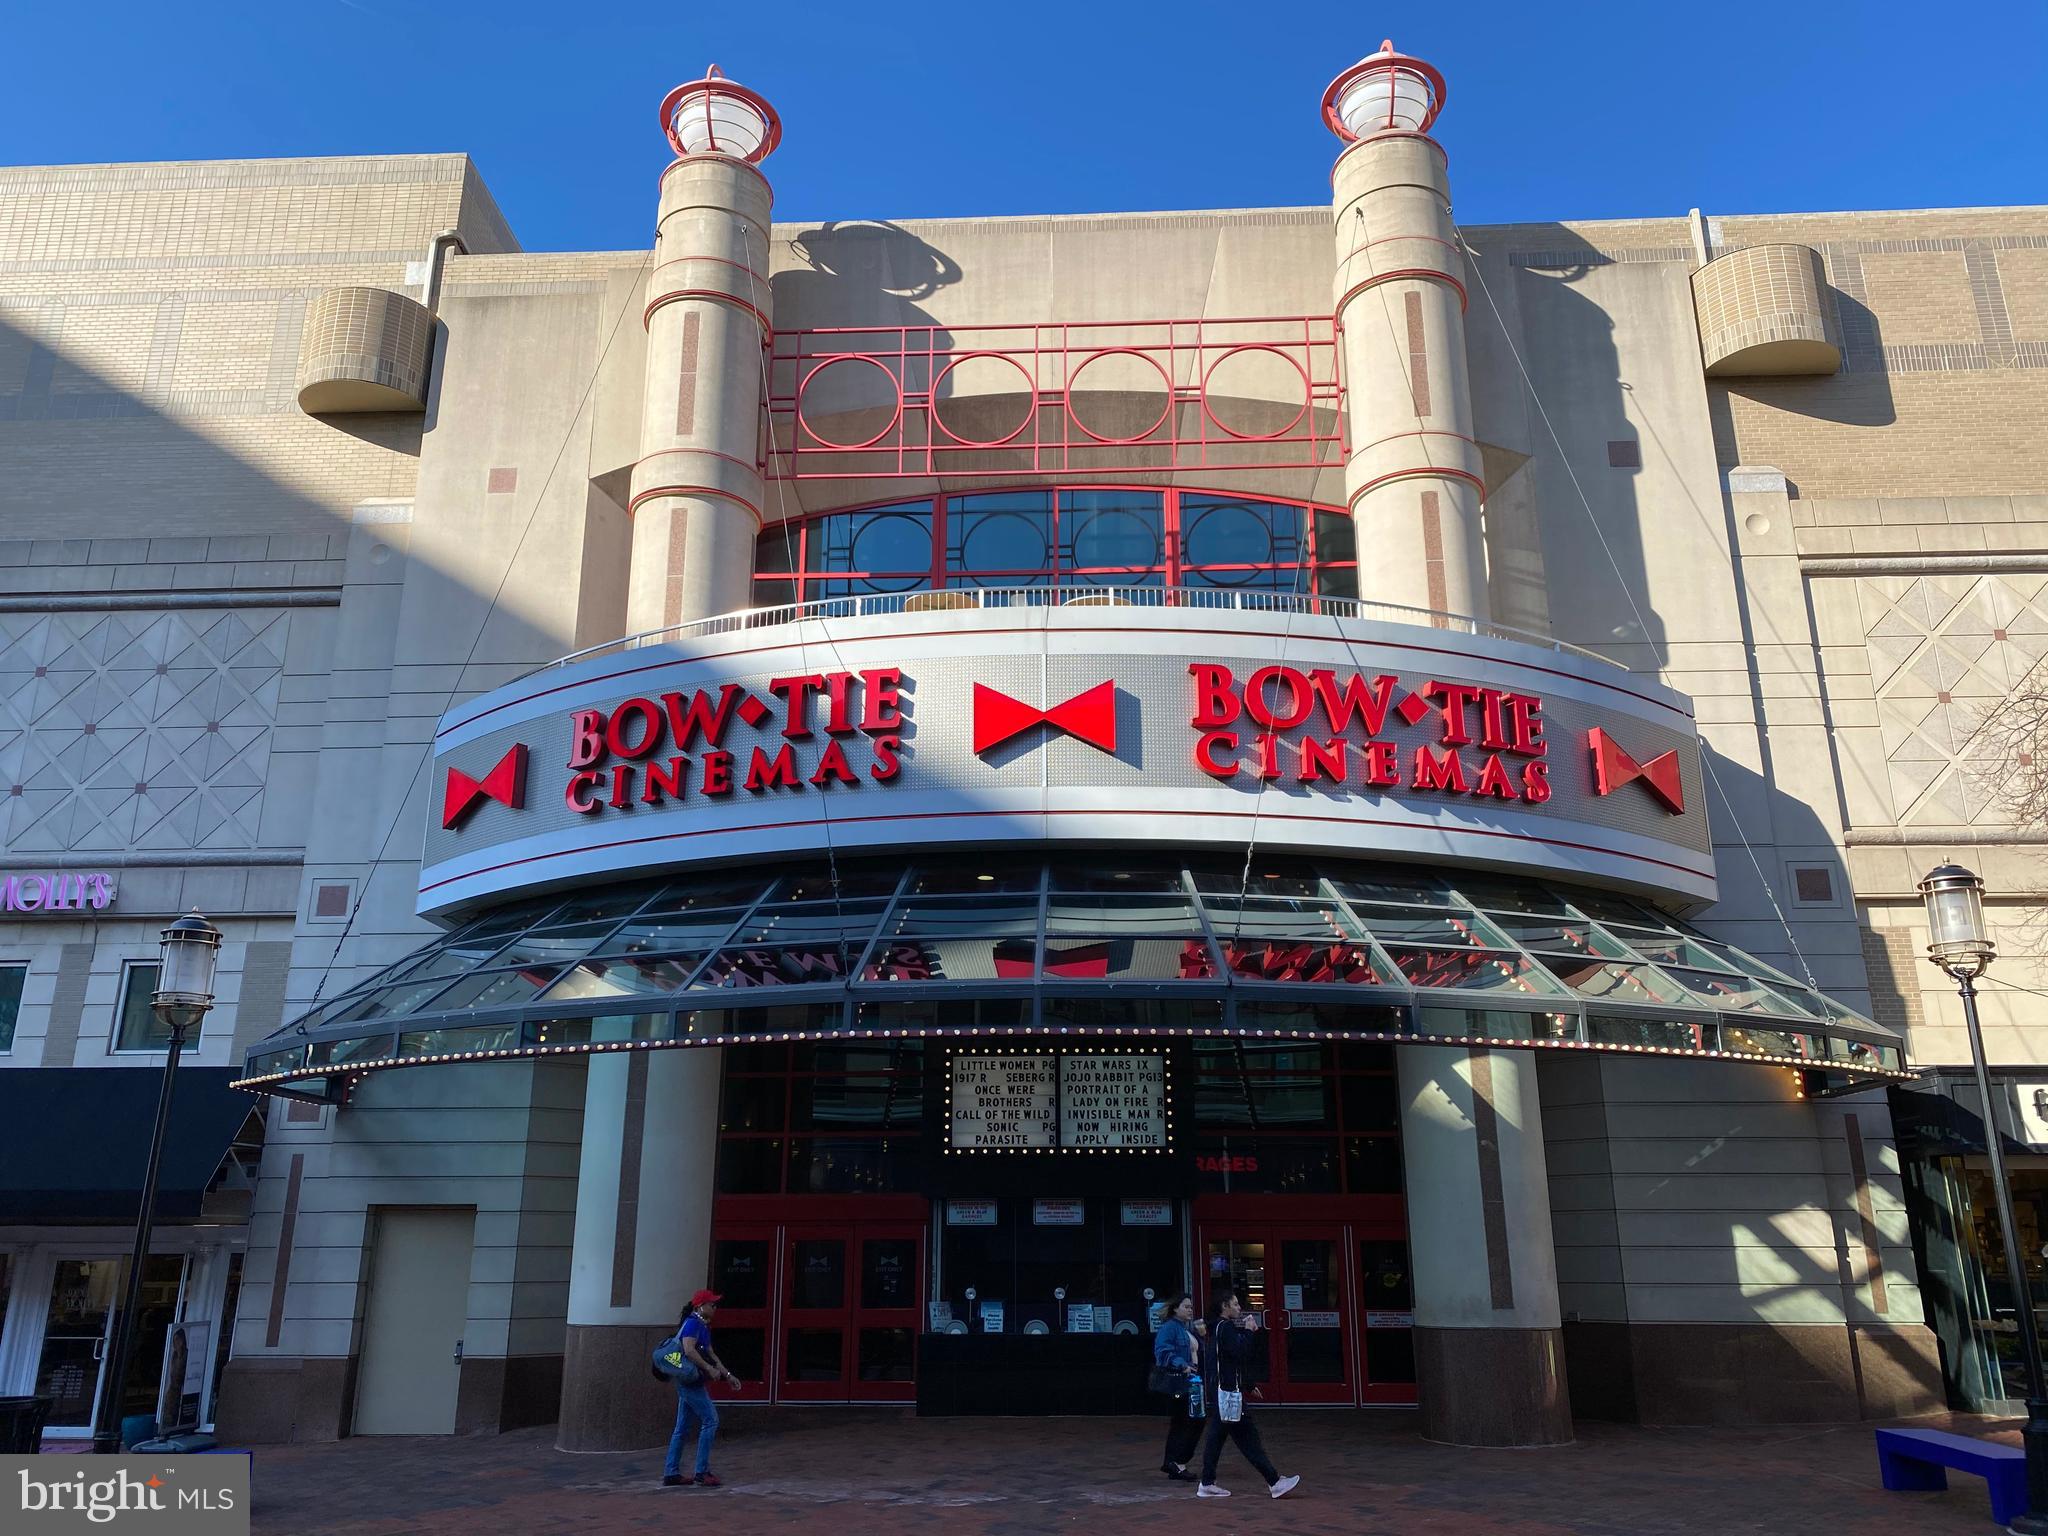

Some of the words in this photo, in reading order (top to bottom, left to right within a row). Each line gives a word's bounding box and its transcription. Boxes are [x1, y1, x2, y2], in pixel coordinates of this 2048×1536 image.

[1194, 730, 1552, 804] CINEMAS
[566, 734, 902, 815] CINEMAS
[960, 1060, 997, 1070] LITTLE
[999, 1060, 1035, 1070] WOMEN
[1042, 1060, 1055, 1070] PG
[1070, 1060, 1097, 1070] STAR
[1102, 1060, 1131, 1070] WARS
[1137, 1060, 1148, 1070] IX
[954, 1073, 976, 1083] 1917
[980, 1073, 987, 1083] R
[1006, 1073, 1046, 1083] SEBERG
[1048, 1073, 1055, 1083] R
[1064, 1073, 1091, 1082] JOJO
[1096, 1073, 1134, 1082] RABBIT
[1139, 1073, 1163, 1082] PG13
[974, 1085, 1001, 1095] ONCE
[1008, 1085, 1035, 1095] WERE
[1067, 1085, 1120, 1095] PORTRAIT
[1123, 1085, 1137, 1095] OF
[1142, 1085, 1148, 1095] A
[978, 1097, 1032, 1107] BROTHERS
[1049, 1097, 1055, 1107] R
[1073, 1097, 1100, 1107] LADY
[1105, 1097, 1119, 1107] ON
[1124, 1097, 1148, 1107] FIRE
[1157, 1097, 1163, 1107] R
[955, 1110, 981, 1120] CALL
[985, 1110, 998, 1120] OF
[1001, 1110, 1020, 1120] THE
[1023, 1110, 1050, 1120] WILD
[1068, 1110, 1122, 1119] INVISIBLE
[1128, 1110, 1150, 1119] MAN
[1157, 1110, 1163, 1119] R
[986, 1123, 1019, 1132] SONIC
[1042, 1123, 1056, 1132] PG
[1077, 1122, 1100, 1132] NOW
[1110, 1122, 1148, 1132] HIRING
[975, 1135, 1028, 1145] PARASITE
[1049, 1135, 1055, 1145] R
[1075, 1135, 1109, 1145] APPLY
[1121, 1135, 1158, 1145] INSIDE
